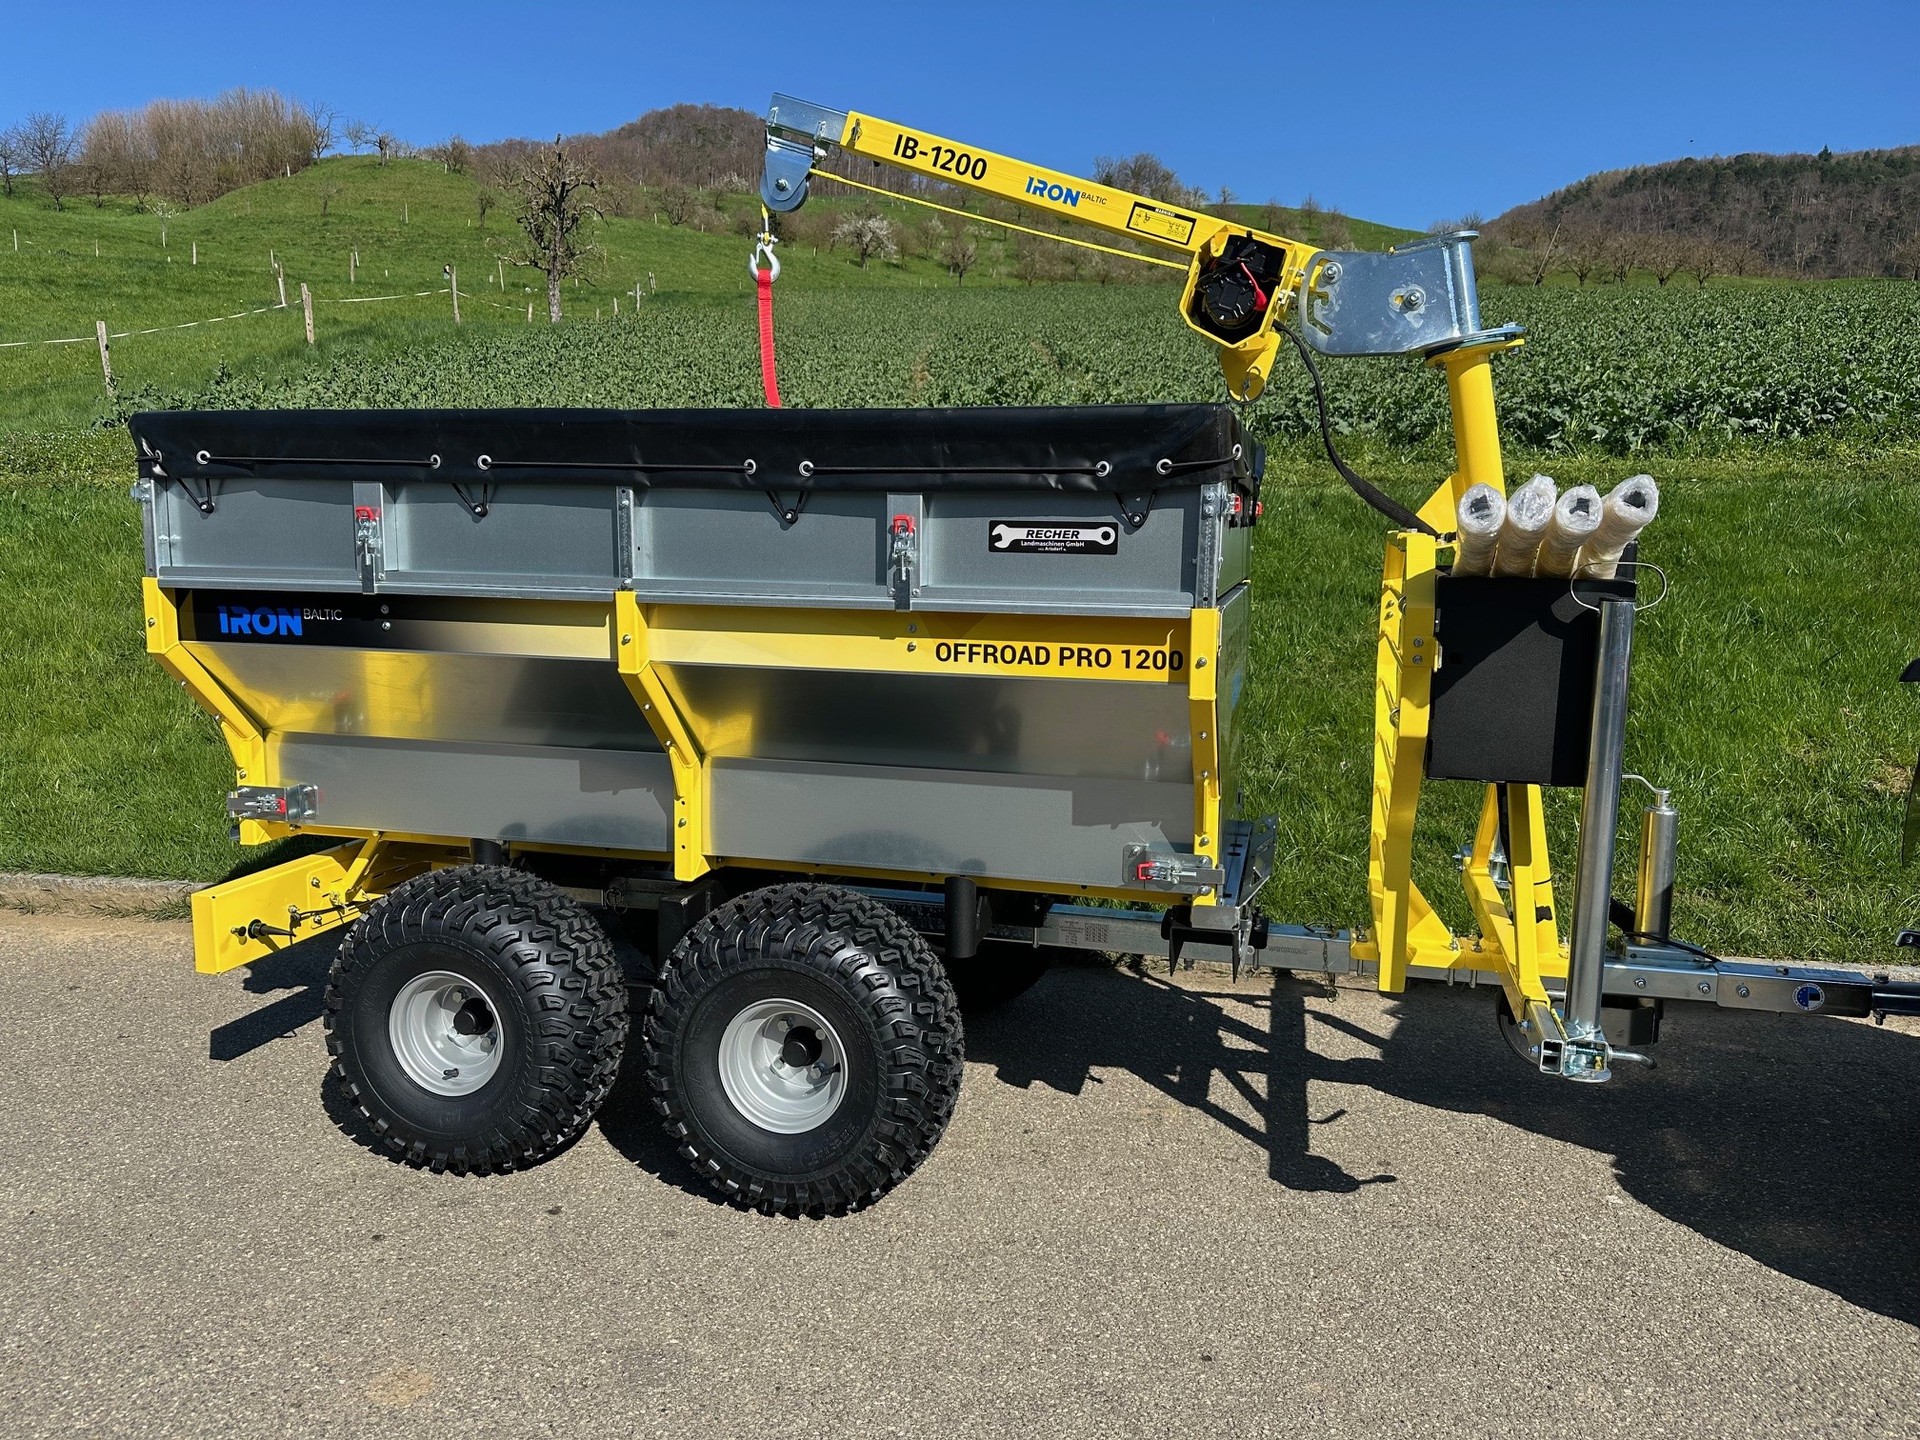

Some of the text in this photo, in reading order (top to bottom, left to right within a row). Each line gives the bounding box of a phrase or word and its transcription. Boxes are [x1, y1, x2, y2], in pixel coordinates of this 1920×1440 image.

[893, 133, 987, 181] IB-1200
[1025, 176, 1107, 208] IRON BALTIC
[1026, 529, 1080, 539] RECHER
[217, 605, 342, 637] IRON BALTIC
[935, 642, 1184, 671] OFFROAD PRO 1200
